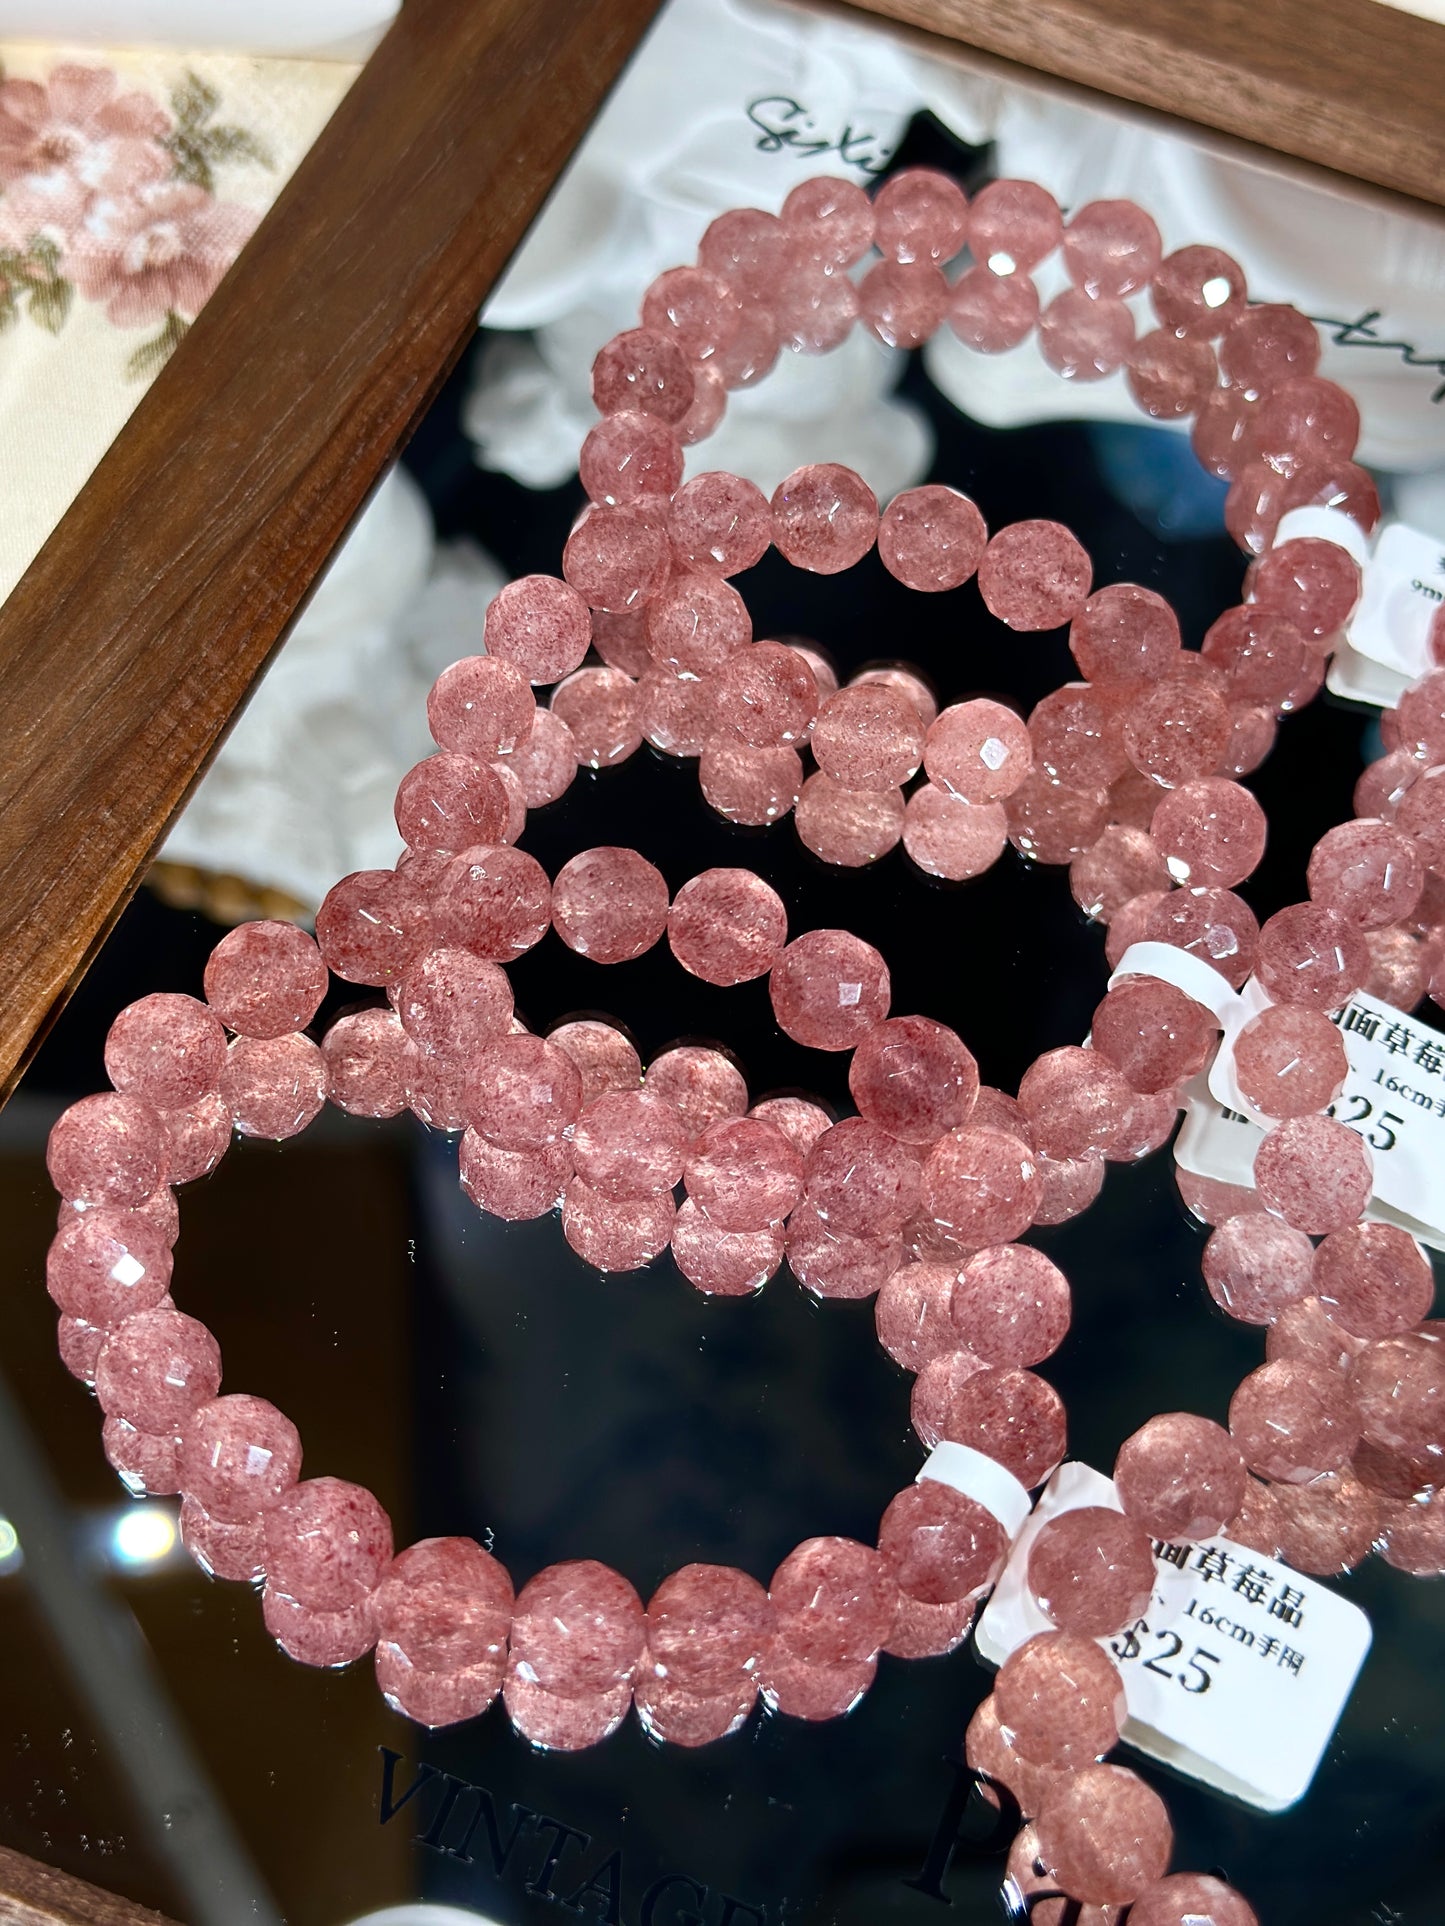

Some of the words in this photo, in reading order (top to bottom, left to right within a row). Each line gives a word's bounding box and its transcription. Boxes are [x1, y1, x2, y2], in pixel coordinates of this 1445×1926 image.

[1331, 1002, 1445, 1082] 面草莓
[1327, 1095, 1405, 1151] 25
[1111, 1618, 1221, 1693] $25
